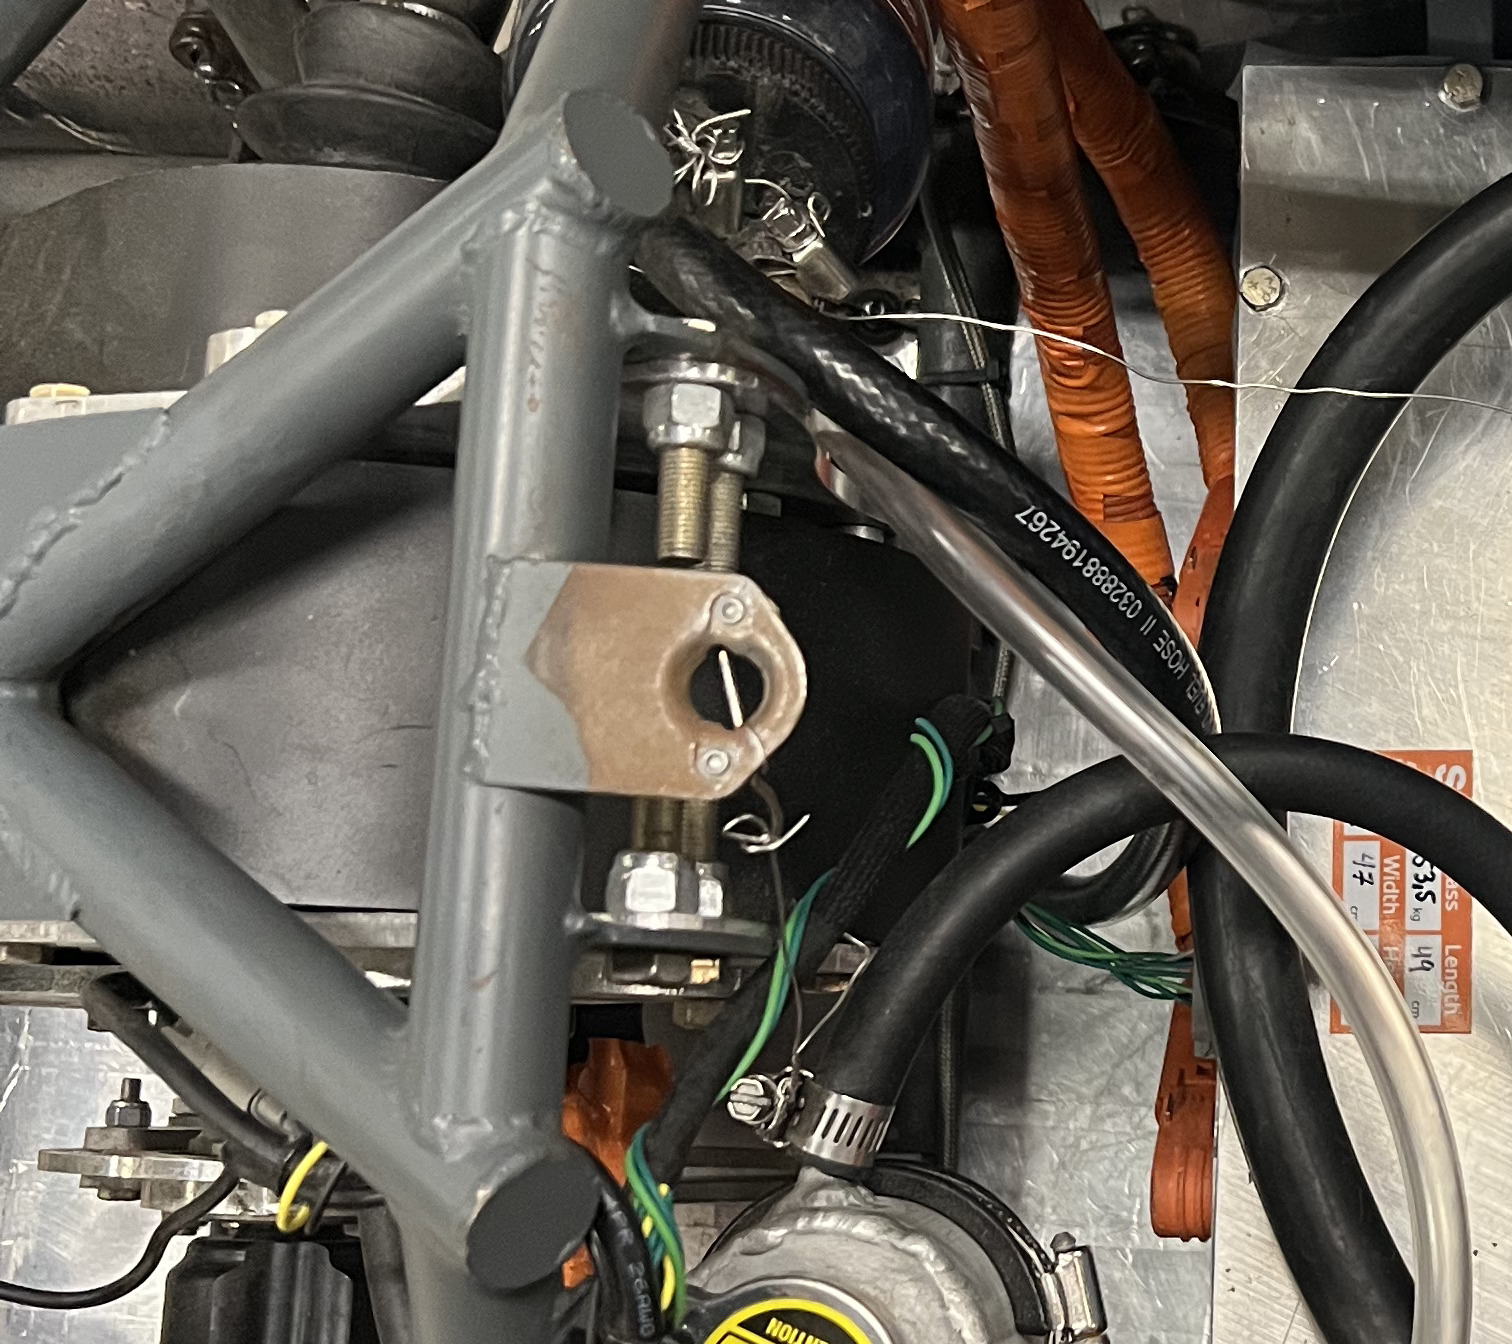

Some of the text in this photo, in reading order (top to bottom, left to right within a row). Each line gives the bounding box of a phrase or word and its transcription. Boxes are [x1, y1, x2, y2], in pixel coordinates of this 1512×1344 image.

[1014, 505, 1143, 619] 032888194267
[1153, 629, 1191, 680] HOSE
[1352, 853, 1376, 887] 47
[1383, 854, 1401, 915] Width
[1445, 875, 1460, 912] ass
[1410, 907, 1423, 922] kg
[1408, 946, 1435, 1019] 49 cm
[1444, 944, 1462, 1015] Length
